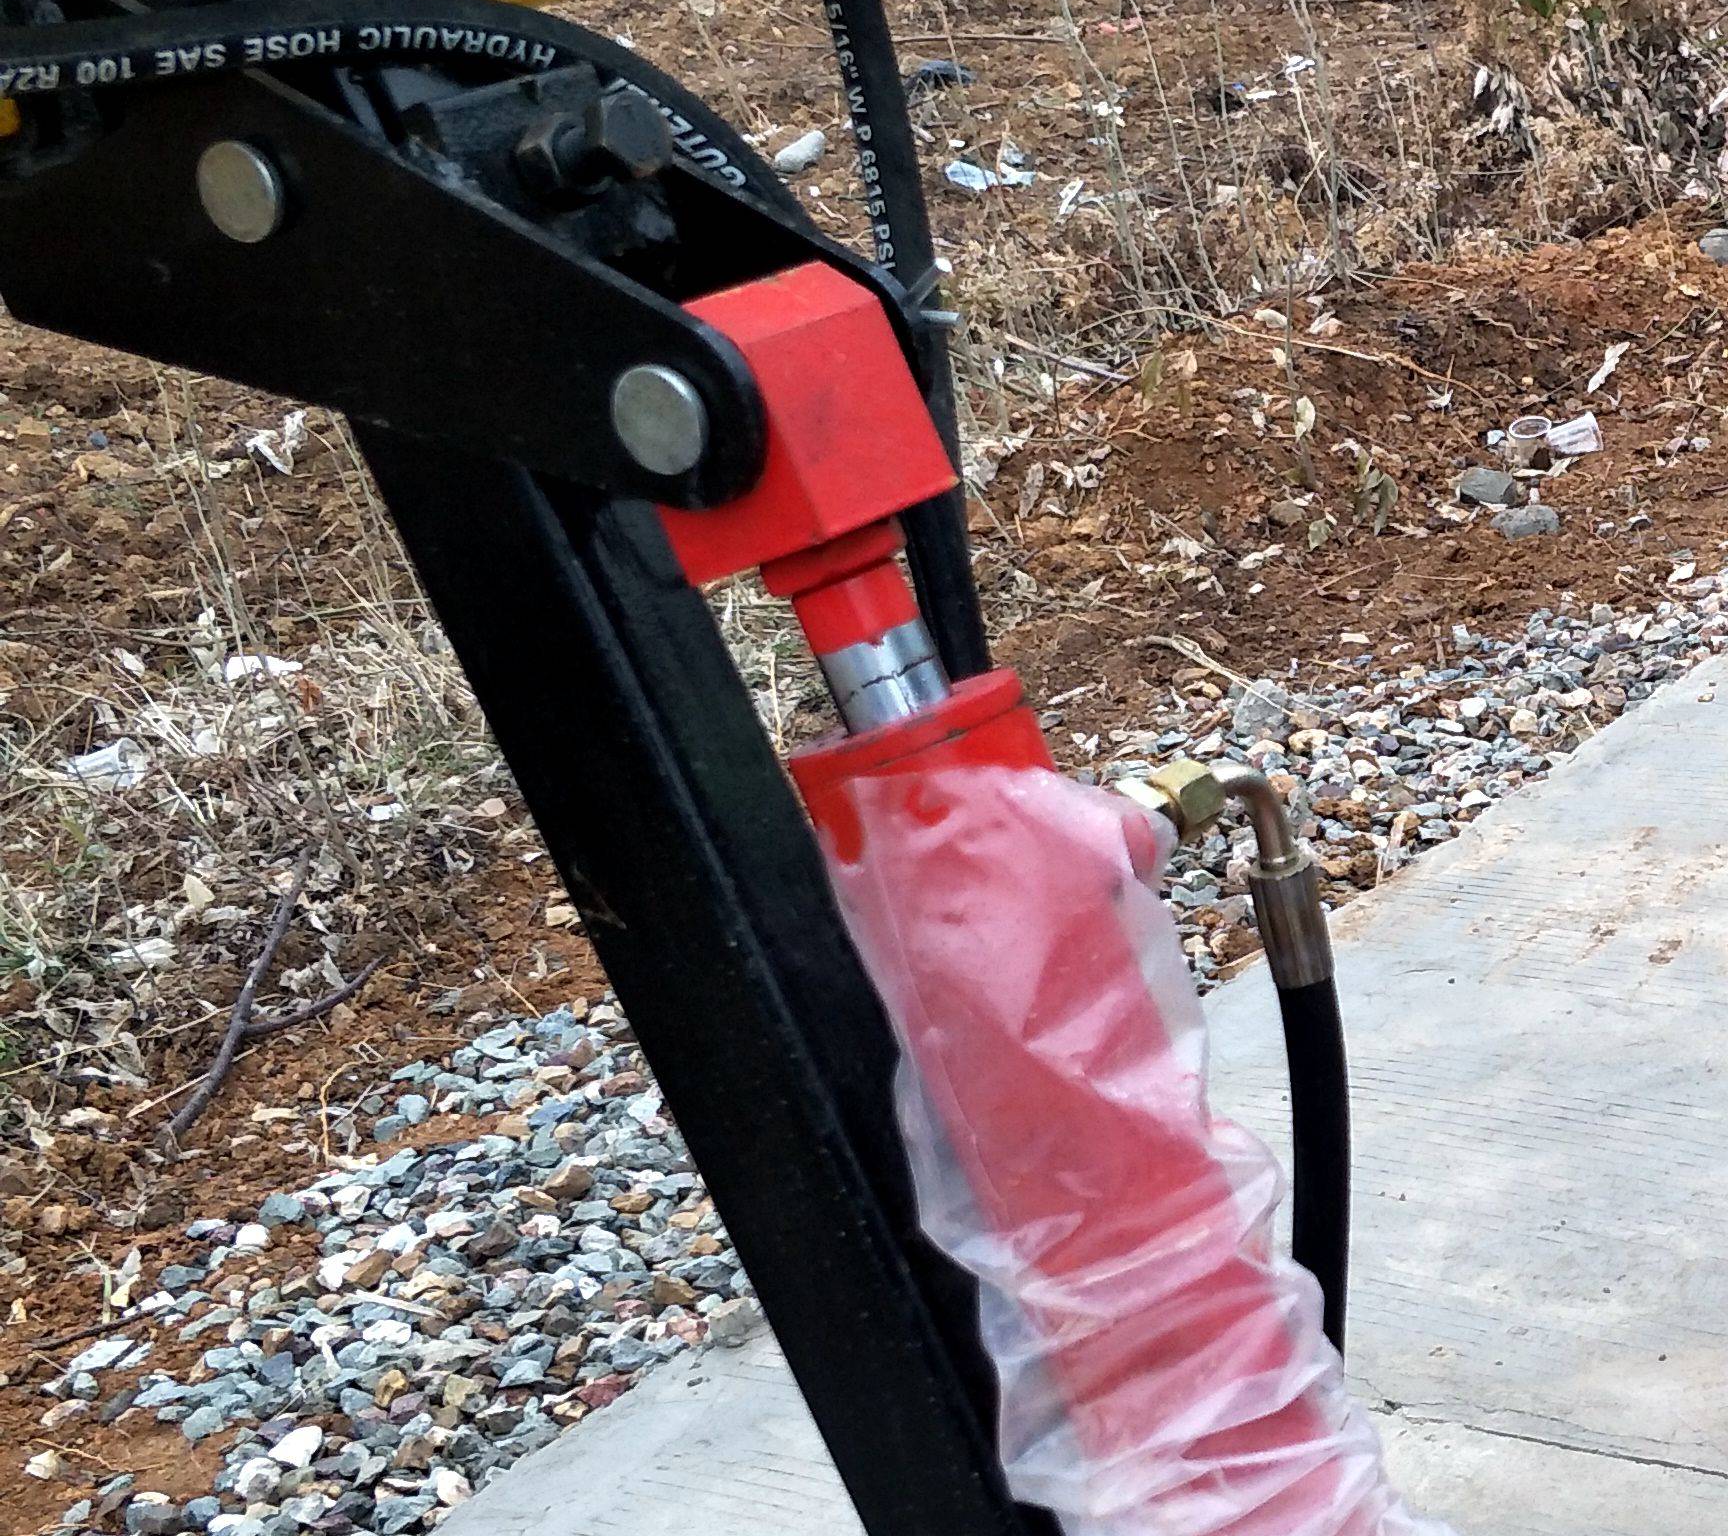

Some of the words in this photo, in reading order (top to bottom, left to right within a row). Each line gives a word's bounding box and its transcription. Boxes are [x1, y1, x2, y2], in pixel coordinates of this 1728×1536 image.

[155, 43, 227, 76] SAE
[243, 29, 341, 63] HOSE
[358, 25, 556, 66] HYDRAULIC
[76, 56, 136, 85] 100
[862, 150, 886, 217] 6815
[876, 224, 896, 271] PSI
